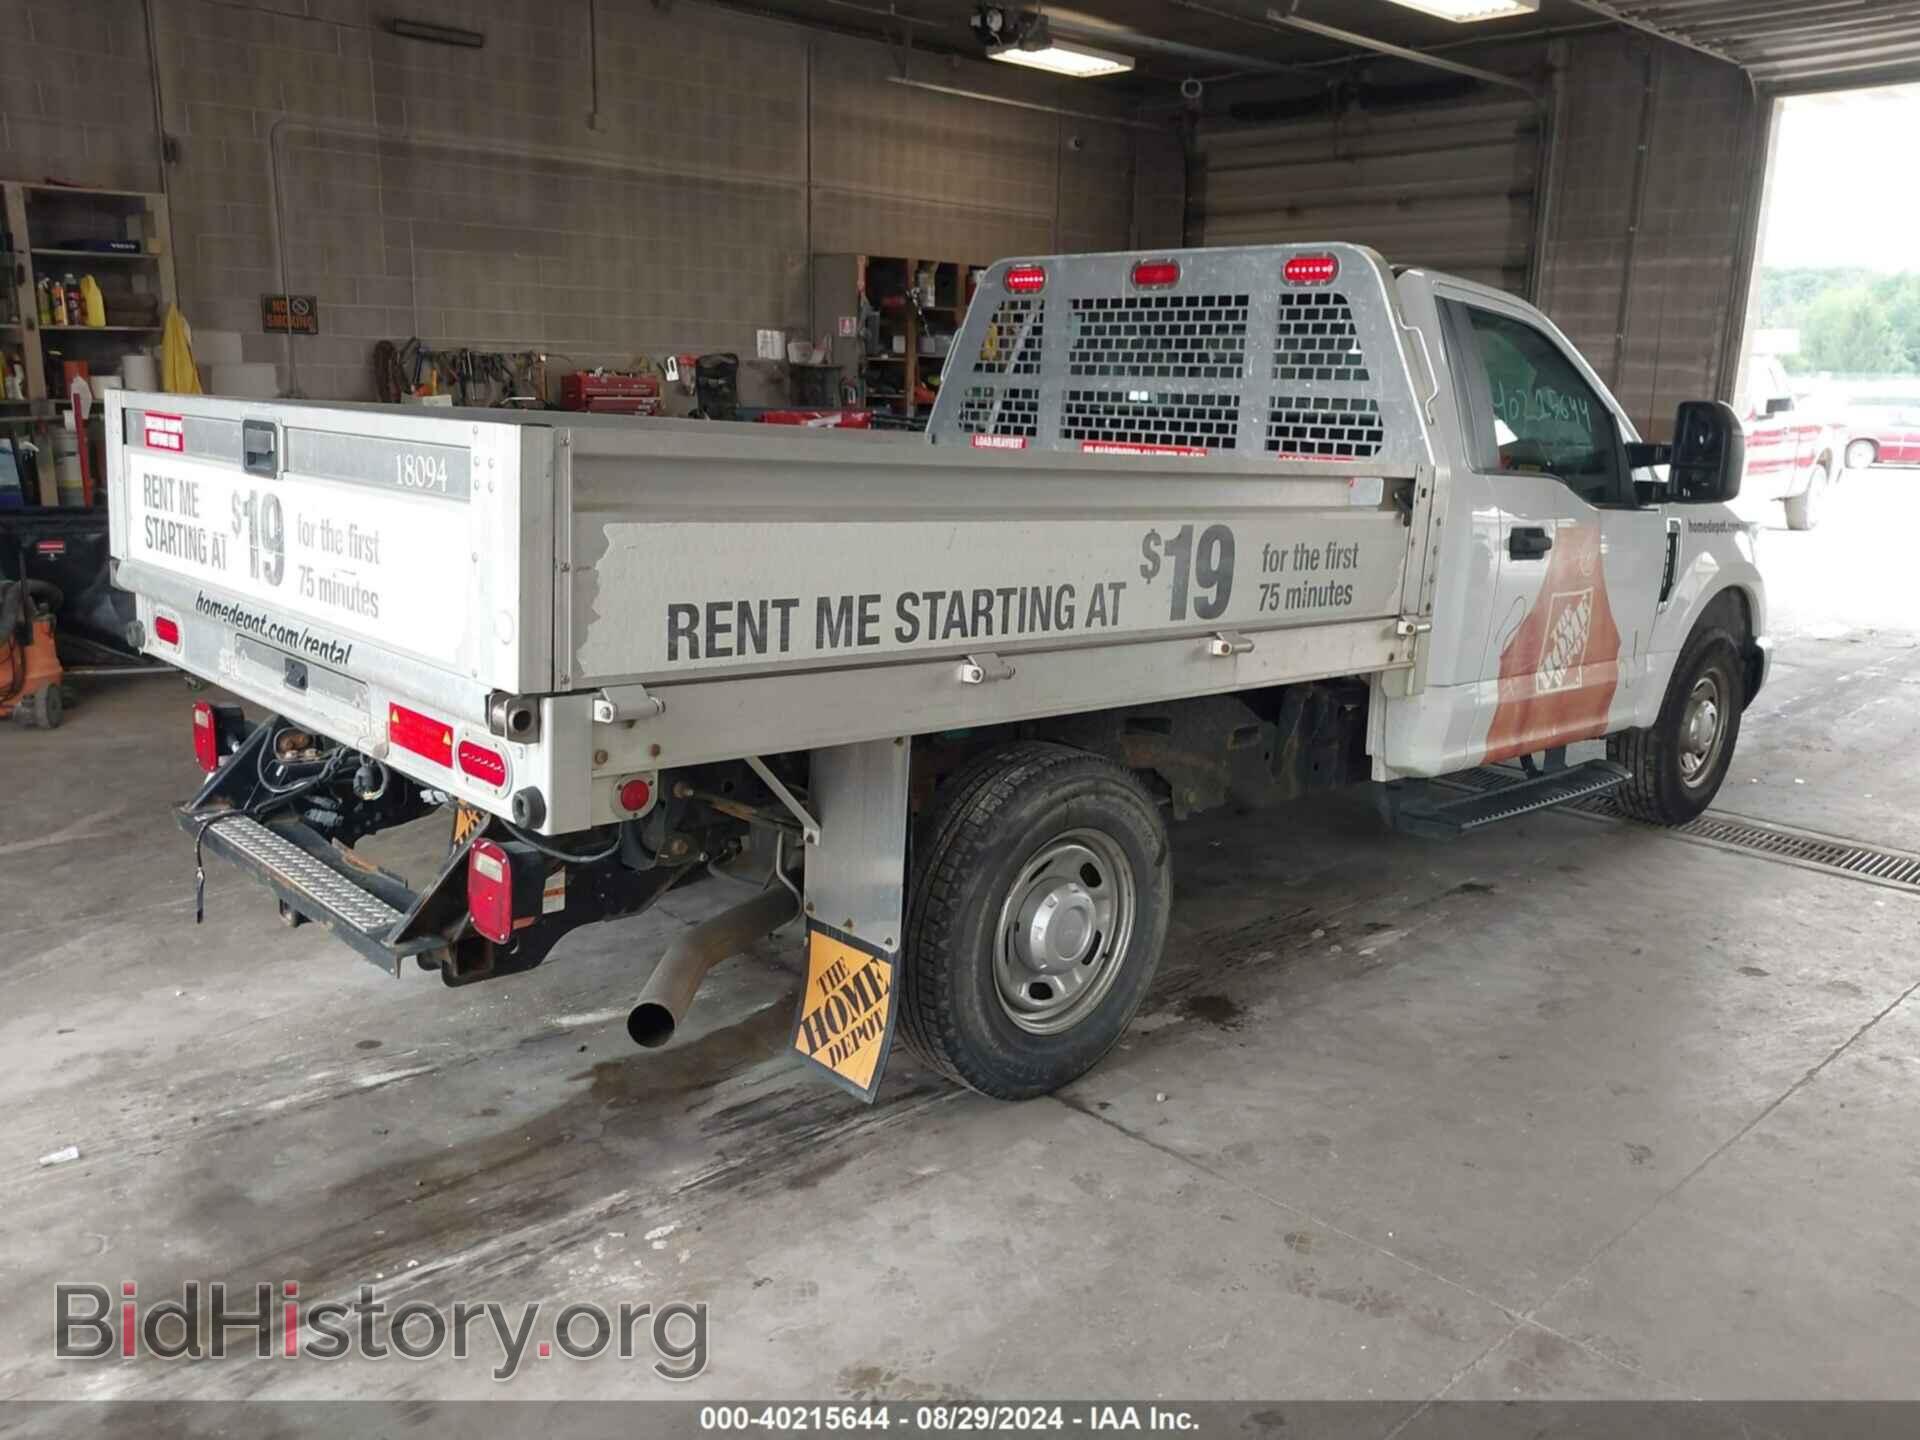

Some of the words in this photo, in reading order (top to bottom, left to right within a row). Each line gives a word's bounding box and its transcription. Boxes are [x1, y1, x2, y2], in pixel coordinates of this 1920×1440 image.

[144, 473, 174, 512] RENT
[179, 479, 200, 518] ME
[396, 453, 448, 492] 18094
[145, 514, 207, 564] STARTING
[211, 532, 228, 570] AT
[297, 513, 315, 548] for
[320, 518, 343, 555] the
[348, 522, 379, 565] first
[1262, 543, 1289, 573] for
[1293, 542, 1320, 571] the
[1325, 541, 1359, 570] first
[298, 564, 314, 598] 75
[318, 572, 379, 619] minutes
[667, 598, 800, 661] RENT
[815, 594, 881, 650] ME
[894, 583, 1076, 643] STARTING
[1084, 582, 1127, 628] AT
[1139, 524, 1236, 622] $19
[1259, 582, 1281, 612] 75
[1285, 580, 1353, 610] minutes
[816, 956, 851, 996] THE
[801, 957, 890, 1056] HOME
[828, 1007, 885, 1068] DEPOT
